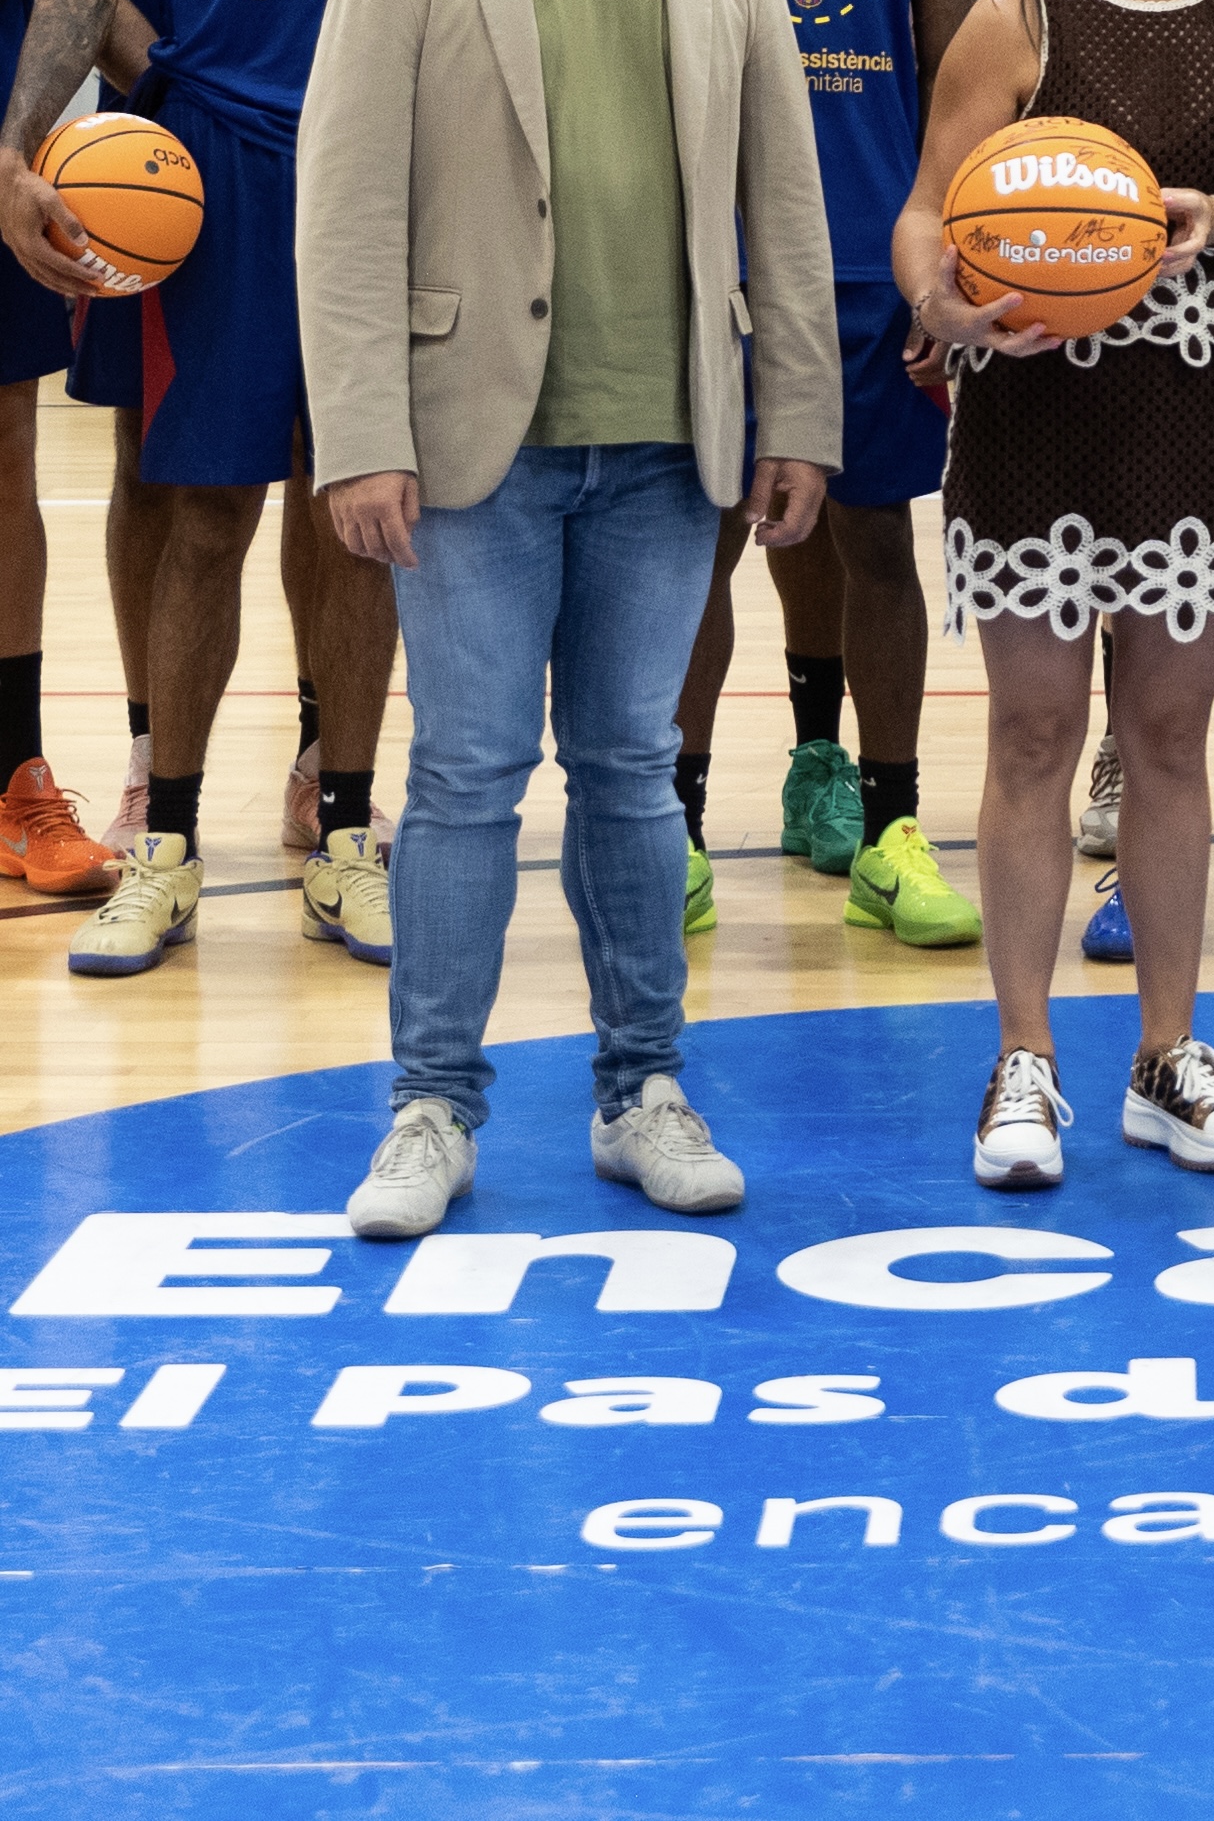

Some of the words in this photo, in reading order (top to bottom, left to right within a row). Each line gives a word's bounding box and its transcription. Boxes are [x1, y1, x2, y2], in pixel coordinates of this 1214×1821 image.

[800, 48, 893, 72] ssistència
[806, 72, 863, 93] nitària
[990, 152, 1140, 203] Wilson
[999, 238, 1041, 264] liga
[1044, 244, 1132, 264] endesa
[312, 1364, 885, 1428] Pas
